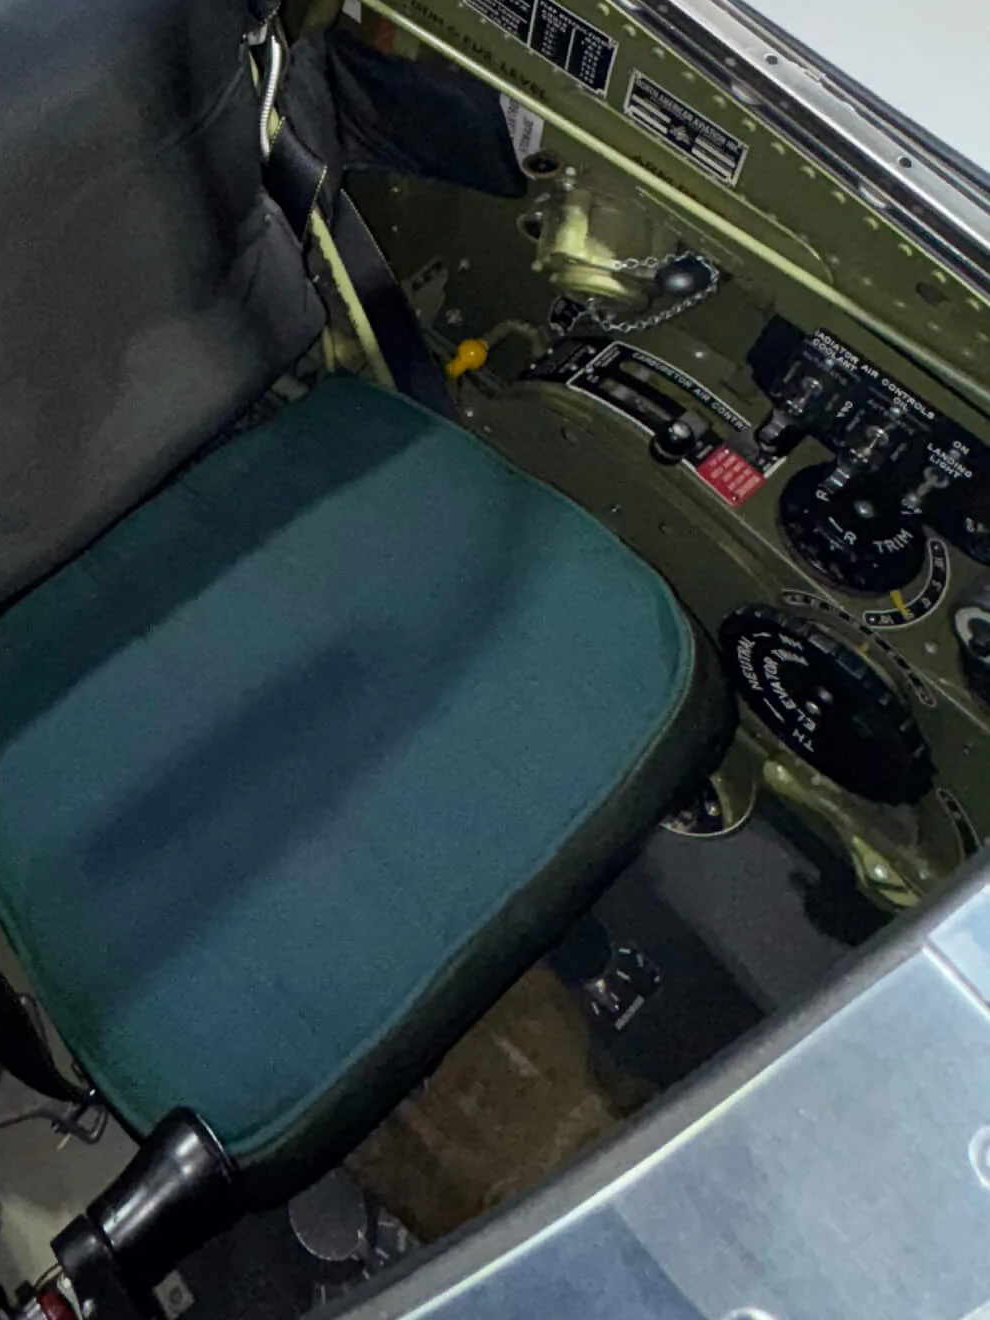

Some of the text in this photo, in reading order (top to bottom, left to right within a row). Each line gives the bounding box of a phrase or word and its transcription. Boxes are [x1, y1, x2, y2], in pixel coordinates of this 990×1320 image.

[812, 338, 859, 373] COOLANT
[693, 387, 711, 403] AIR
[860, 364, 879, 379] AIR
[881, 378, 936, 421] CONTROLS
[893, 396, 908, 412] OIL
[926, 442, 974, 479] LANDING
[952, 440, 971, 455] ON
[929, 454, 962, 479] LIGHT
[843, 531, 858, 546] R
[873, 528, 914, 555] TRIM
[737, 635, 764, 692] NEUTRAL
[763, 655, 817, 732] ELEVATOR
